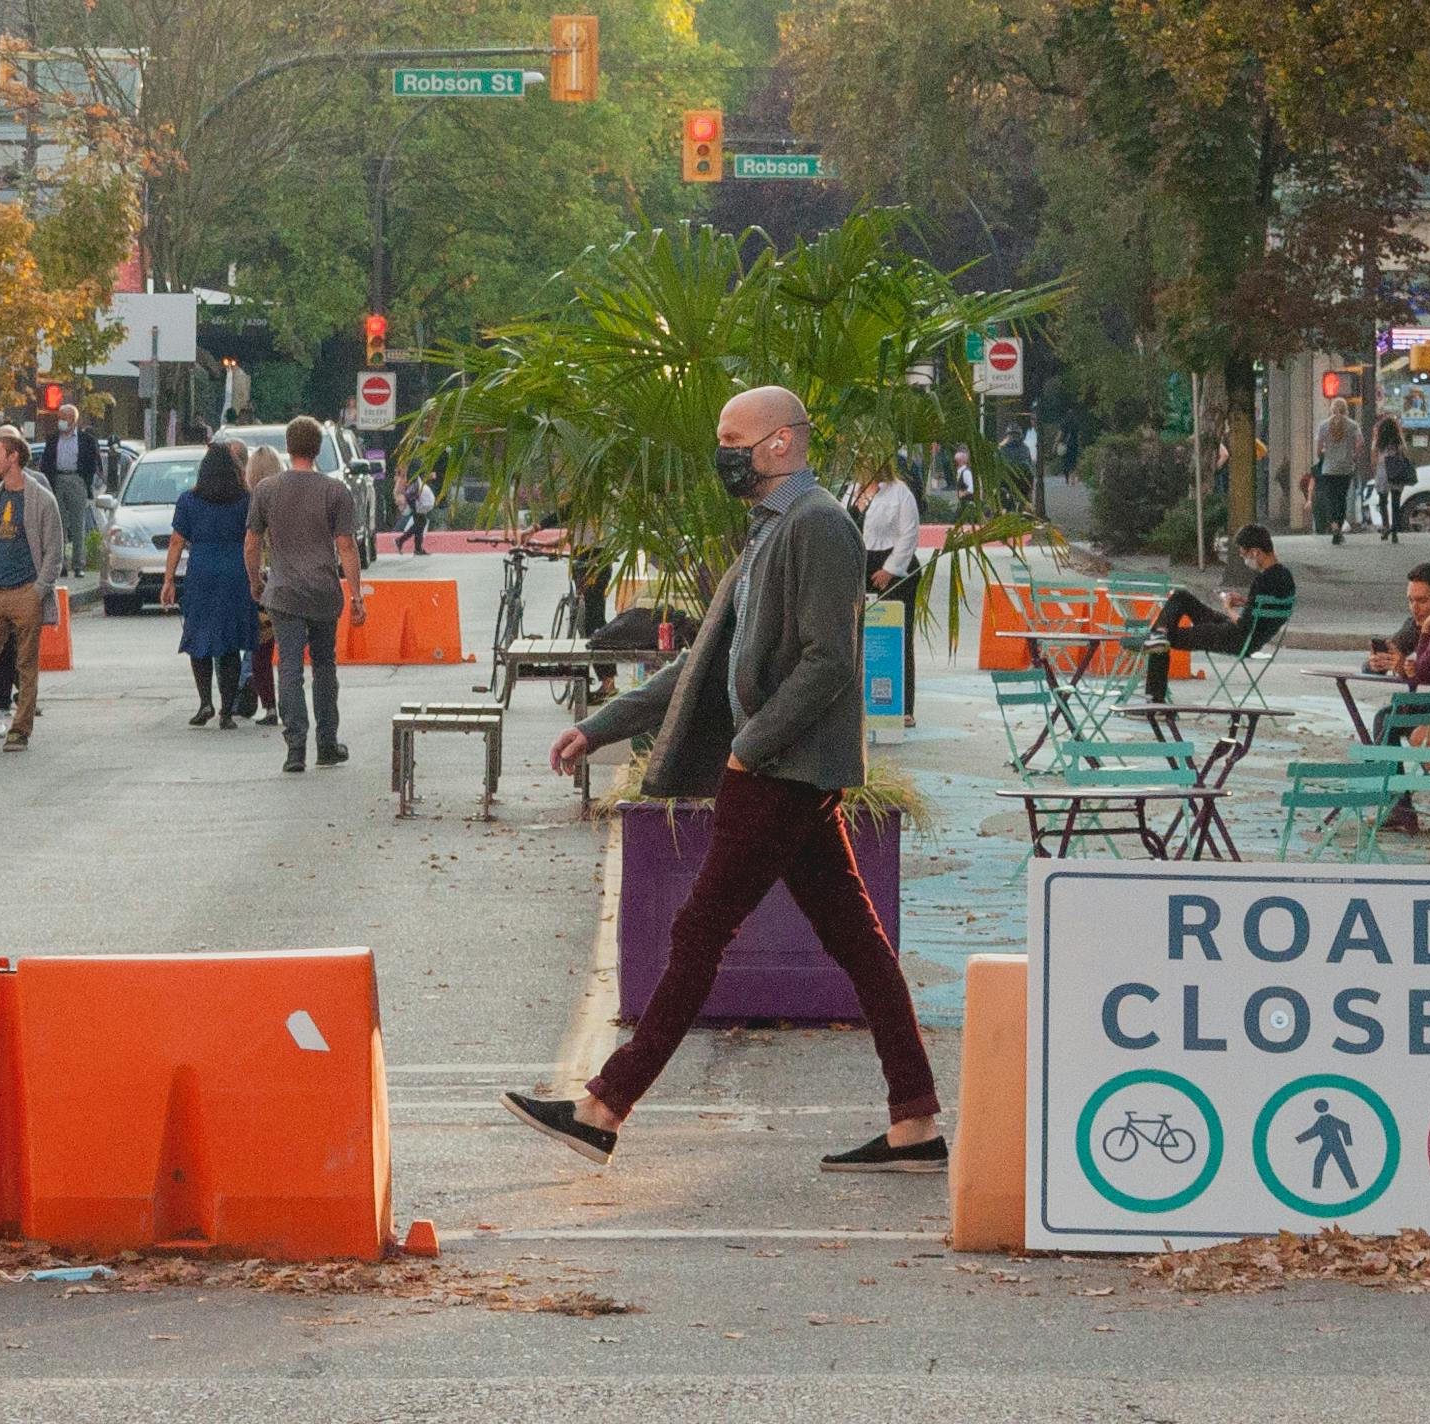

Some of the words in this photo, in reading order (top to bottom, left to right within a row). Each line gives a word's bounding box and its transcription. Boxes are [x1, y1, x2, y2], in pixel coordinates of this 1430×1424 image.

[403, 74, 482, 92] Robson
[491, 74, 514, 92] St
[743, 159, 809, 174] Robson
